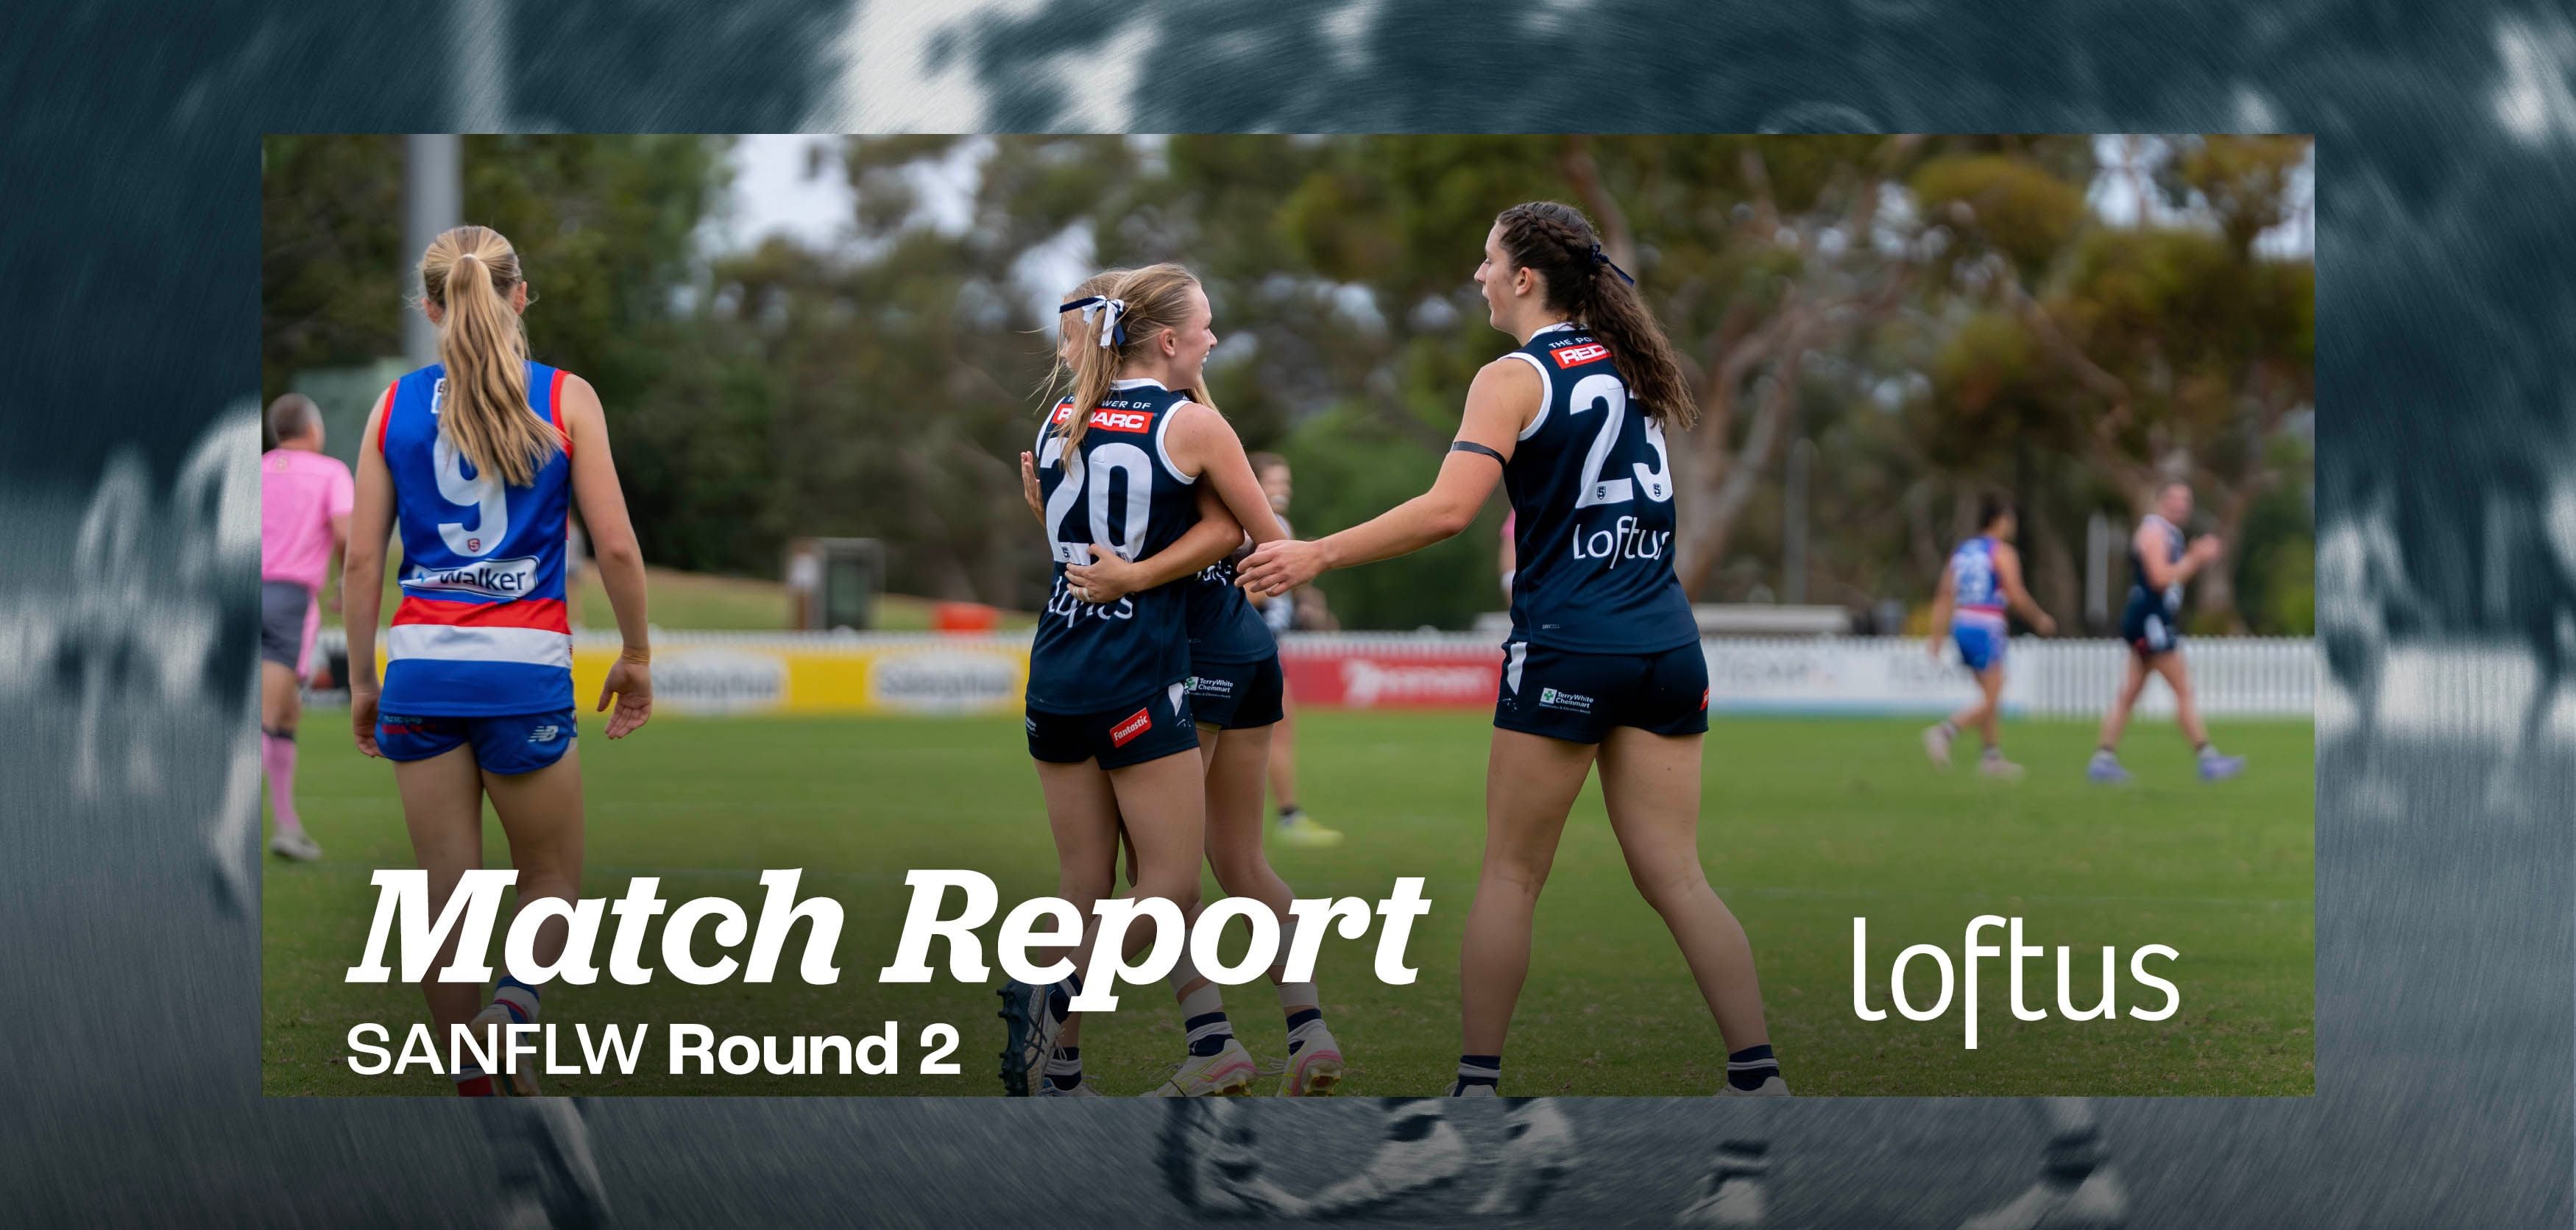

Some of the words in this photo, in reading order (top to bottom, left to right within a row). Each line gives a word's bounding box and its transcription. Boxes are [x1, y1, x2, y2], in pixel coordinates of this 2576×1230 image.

[1549, 339, 1573, 348] THE
[1133, 401, 1151, 409] OF
[1057, 408, 1144, 429] RARC
[1570, 374, 1673, 509] 23
[433, 423, 508, 557] 9
[1040, 437, 1153, 566] 20
[440, 568, 526, 590] walker
[1198, 684, 1231, 693] Chemmart
[1200, 677, 1234, 688] TerryWhite
[1555, 697, 1590, 709] Chemmart
[1557, 691, 1594, 703] TerryWhite
[1114, 715, 1148, 741] Fantastic
